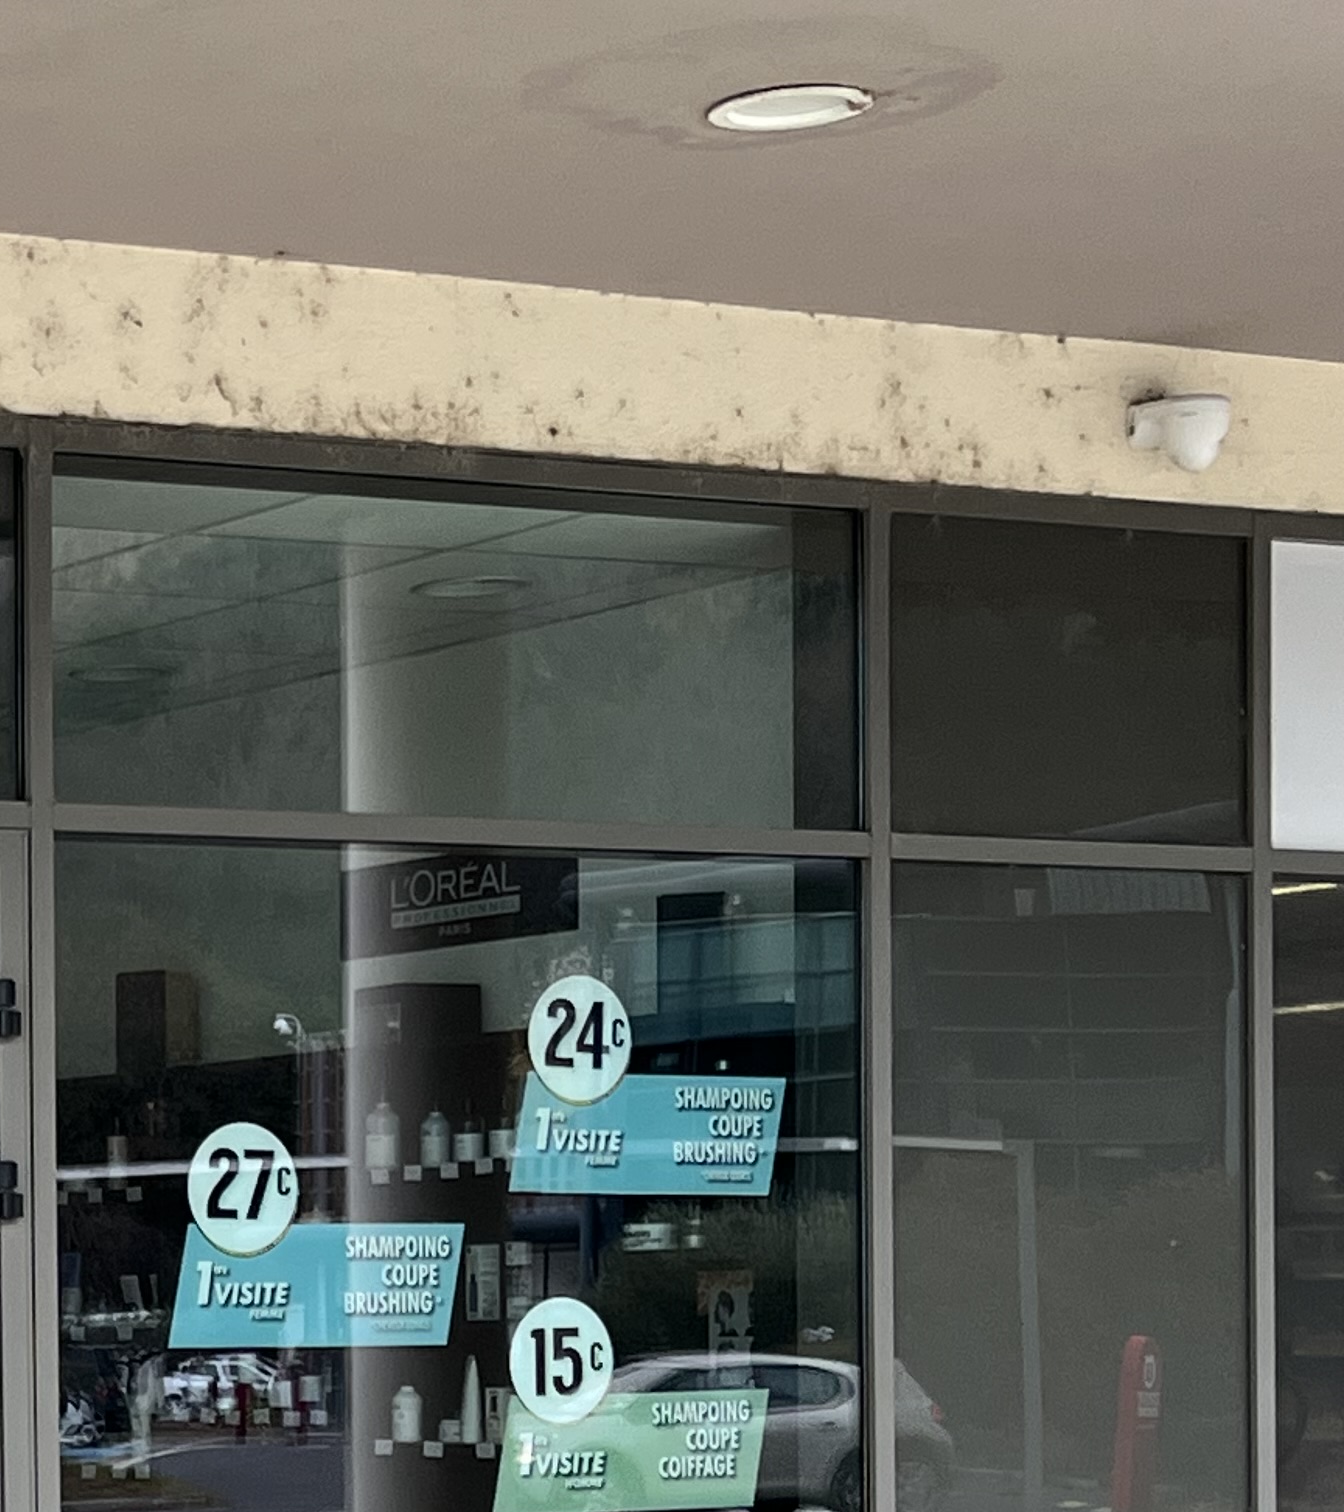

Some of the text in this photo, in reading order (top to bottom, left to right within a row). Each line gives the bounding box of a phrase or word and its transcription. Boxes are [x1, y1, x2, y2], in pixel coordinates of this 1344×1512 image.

[391, 862, 521, 908] L'ORÉAL
[674, 1087, 773, 1111] SHAMPOING
[708, 1114, 763, 1138] COUPE
[552, 1129, 623, 1153] VISITE
[345, 1235, 452, 1259] SHAMPOING
[381, 1264, 440, 1287] COUPE
[214, 1281, 289, 1307] VISITE
[651, 1400, 751, 1426] SHAMPOING
[686, 1428, 741, 1451] COUPE
[536, 1451, 607, 1476] VISITE
[658, 1455, 736, 1479] COIFFAGE
